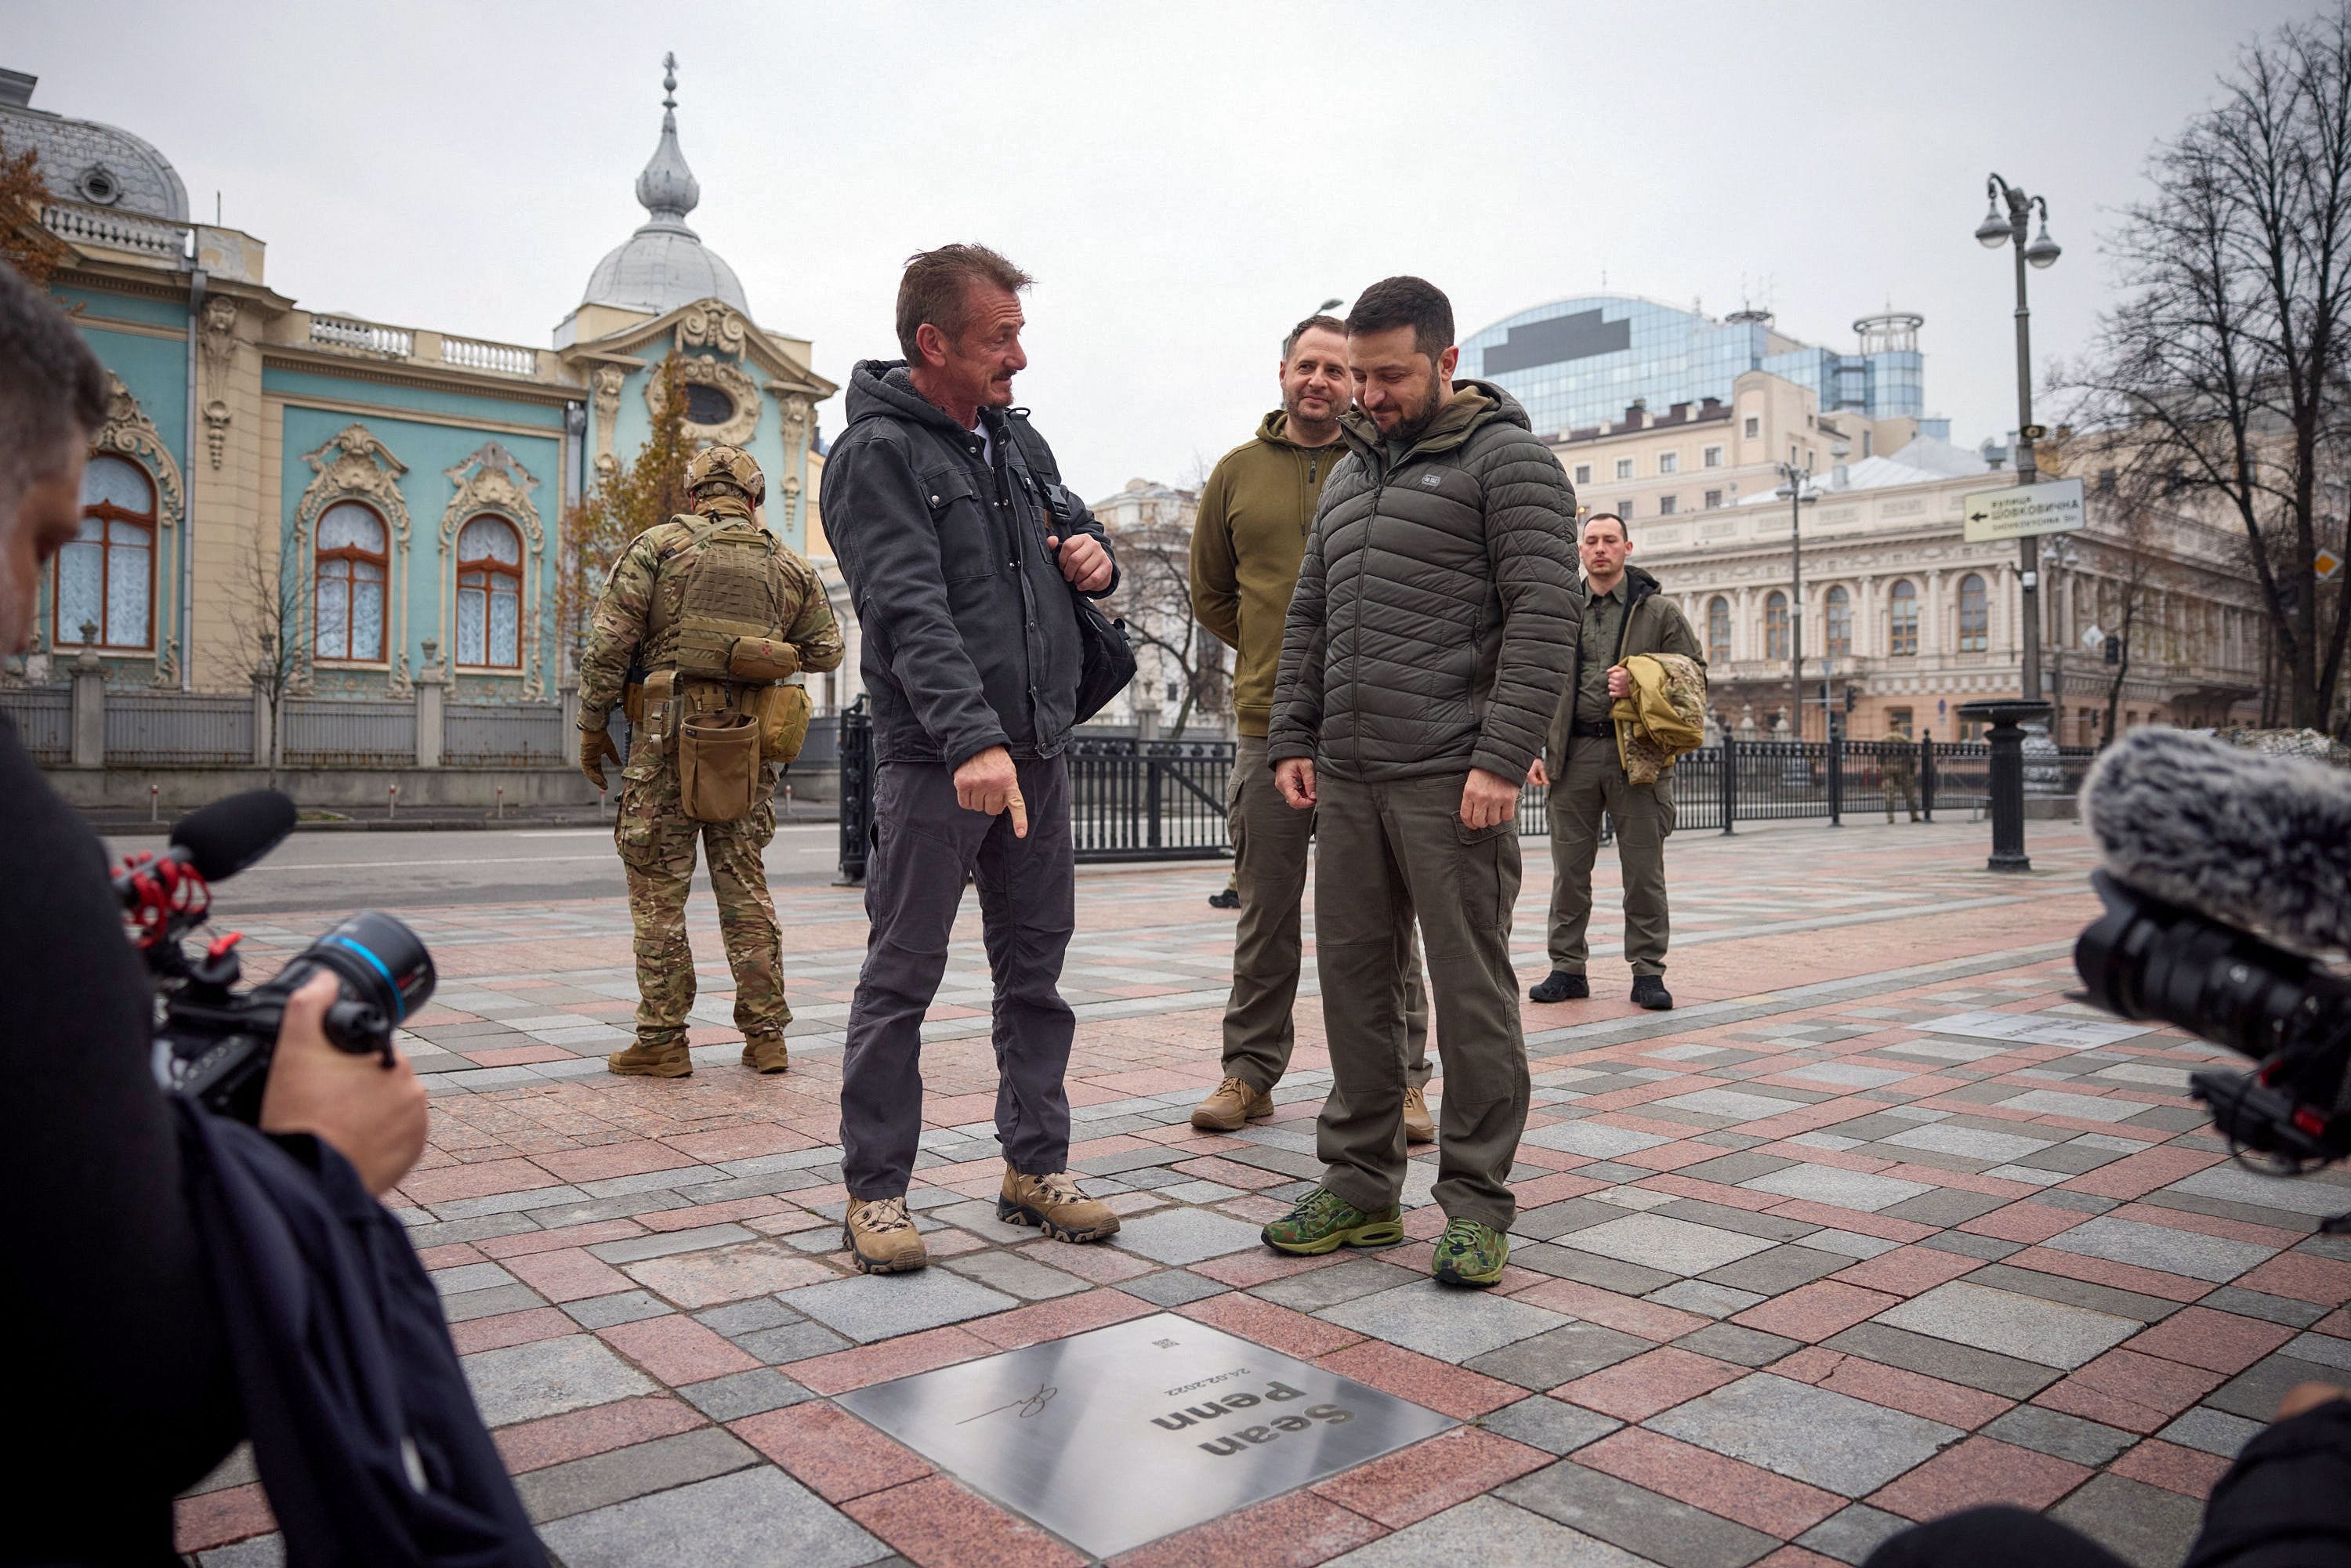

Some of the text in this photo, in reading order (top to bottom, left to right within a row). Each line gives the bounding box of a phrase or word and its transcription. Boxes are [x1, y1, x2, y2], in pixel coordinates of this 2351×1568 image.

[1992, 498, 2079, 520] ШОВКОВИЧНА
[1163, 1367, 1252, 1396] 24.02.2022
[1149, 1380, 1307, 1431] Penn
[1197, 1403, 1356, 1457] Sean
